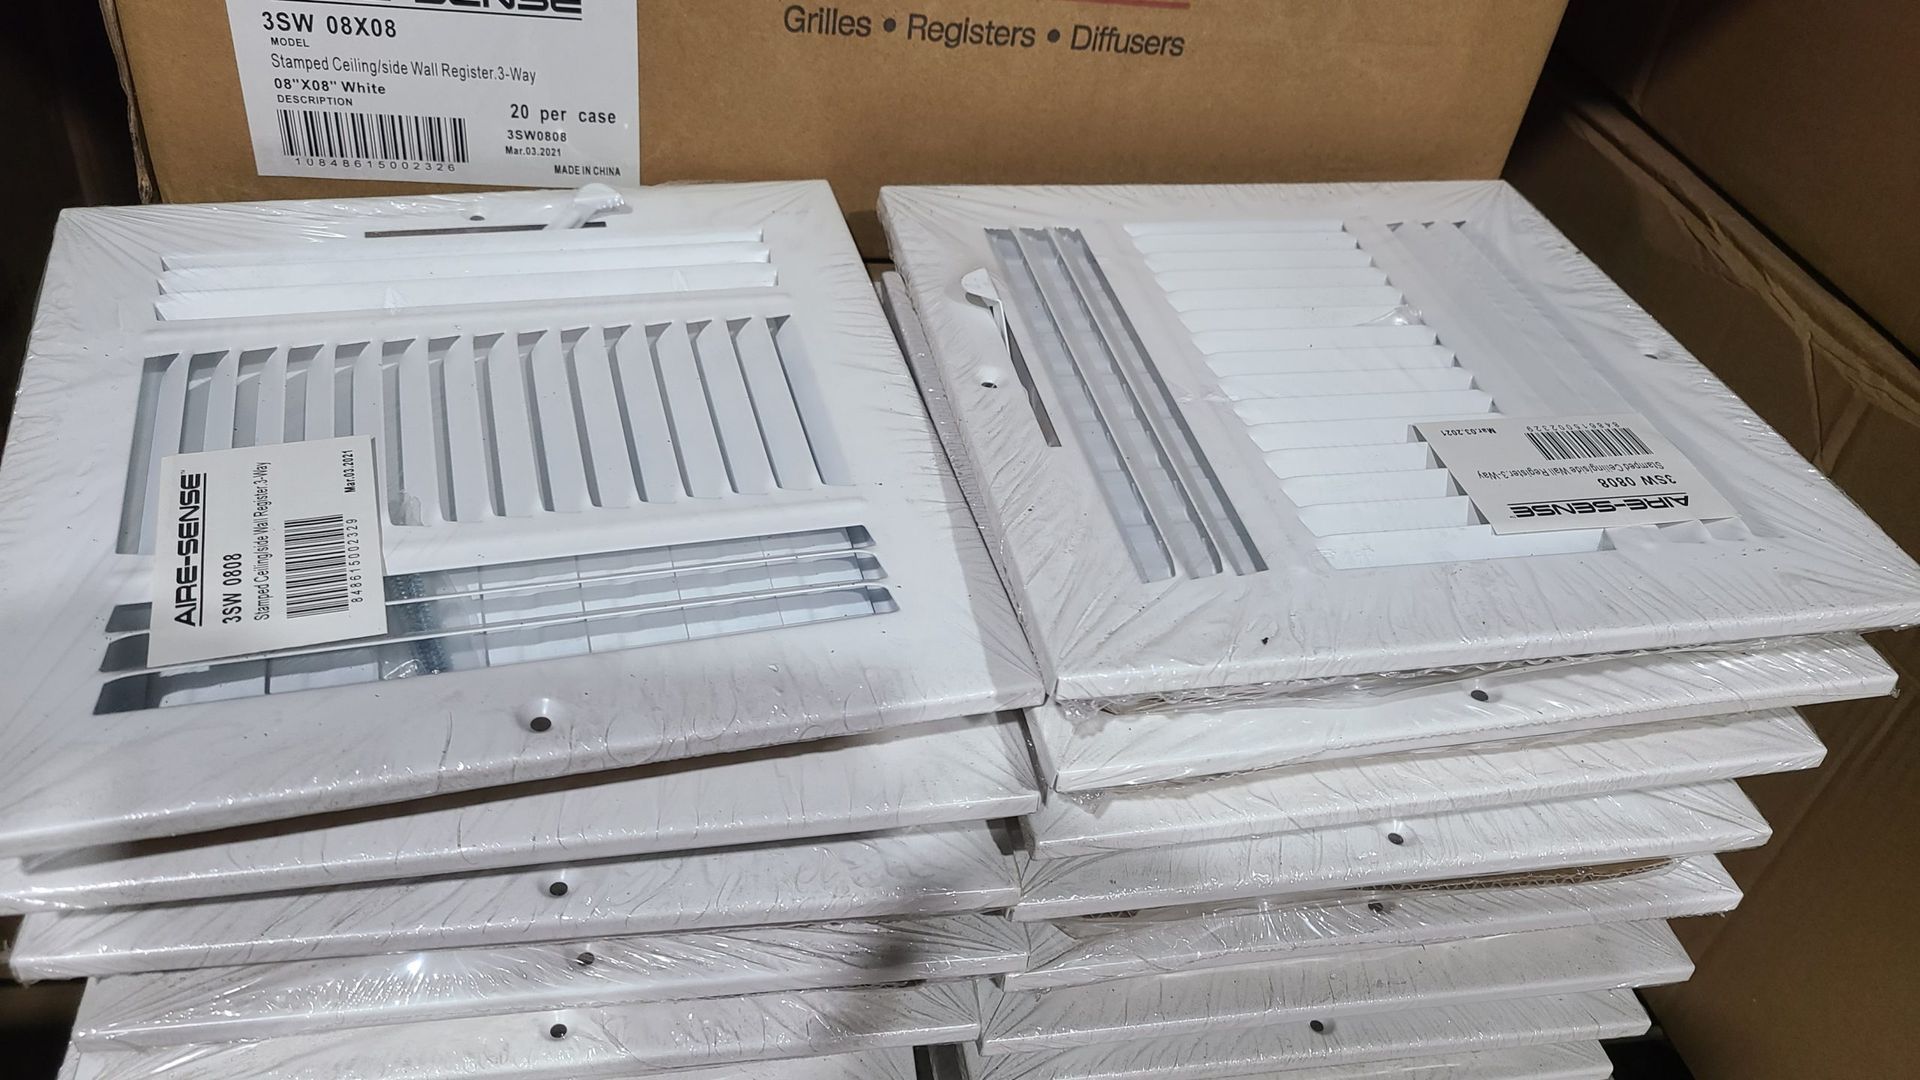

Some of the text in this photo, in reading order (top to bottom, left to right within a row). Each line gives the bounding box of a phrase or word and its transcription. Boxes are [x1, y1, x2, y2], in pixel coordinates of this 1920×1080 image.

[261, 11, 397, 38] 3SW 08X08
[783, 4, 1186, 57] Grilles Registers Diffusers
[270, 36, 310, 48] MODEL
[270, 52, 537, 85] Stamped Ceiling/side Wall Register.3-Way
[341, 81, 386, 95] White
[277, 94, 353, 106] DESCRIPTION
[510, 103, 616, 124] 20 per case
[507, 129, 567, 142] 3SW0808
[505, 145, 561, 157] Mar.03.2021
[554, 164, 621, 177] MADE IN CHINA
[342, 449, 356, 493] Mar.03.2021
[1550, 465, 1568, 477] Wall
[1625, 461, 1664, 472] Stamped
[1597, 474, 1677, 488] 3SW 0808
[1509, 495, 1689, 518] AIRE-SENSE
[253, 518, 269, 535] Wall
[174, 473, 202, 627] AIRE-SENSE
[253, 536, 273, 583] Ceiling/side
[222, 552, 242, 624] 3SW 0808
[254, 585, 272, 621] Stamped
